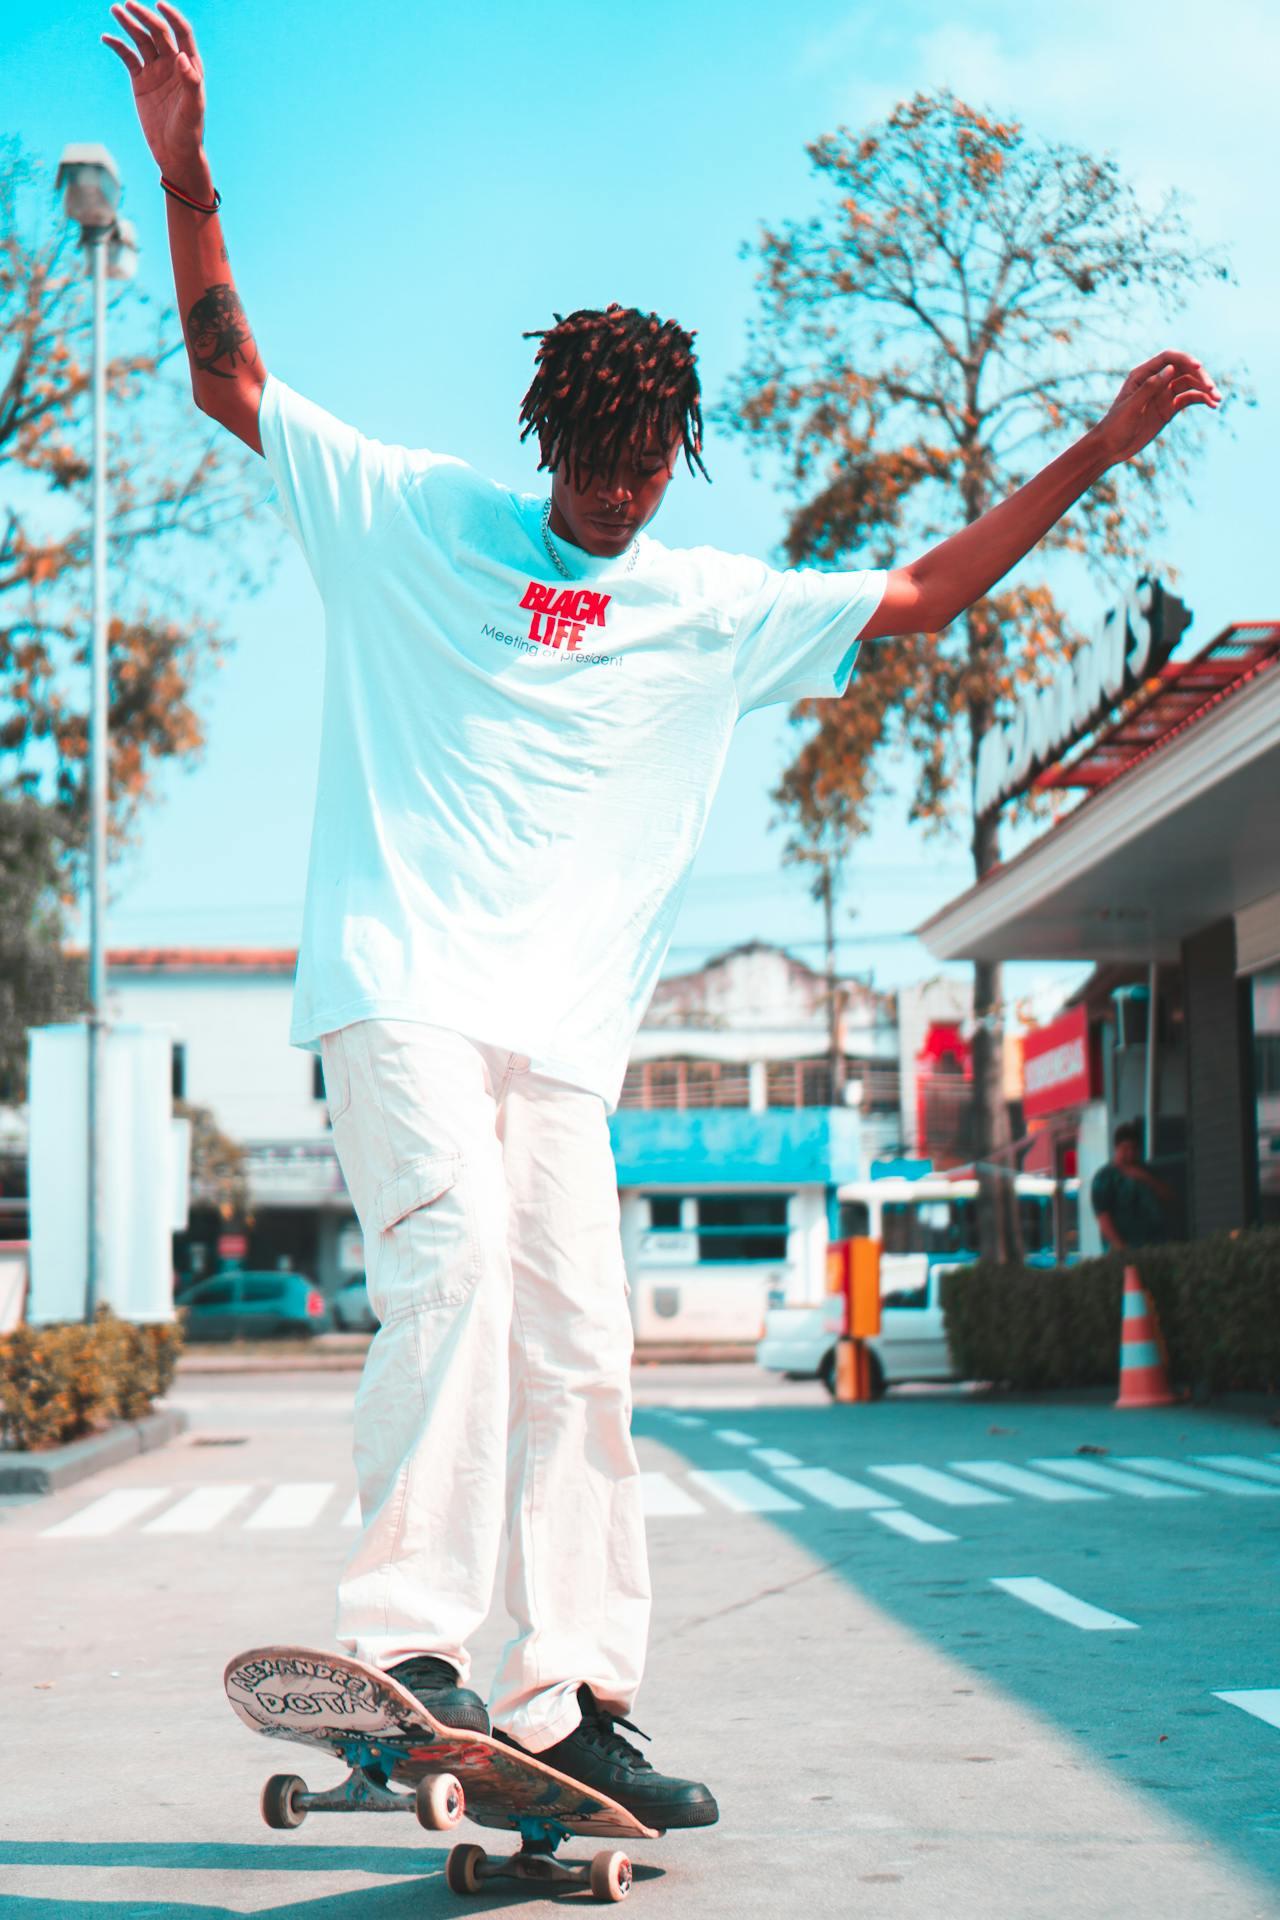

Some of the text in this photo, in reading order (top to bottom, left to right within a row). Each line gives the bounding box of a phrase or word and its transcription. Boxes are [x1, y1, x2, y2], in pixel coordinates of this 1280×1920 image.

[519, 581, 611, 626] BLACK
[481, 624, 538, 656] Meeting
[560, 651, 623, 666] president
[528, 612, 586, 651] LIFE
[230, 1659, 366, 1692] ALEXANDRE
